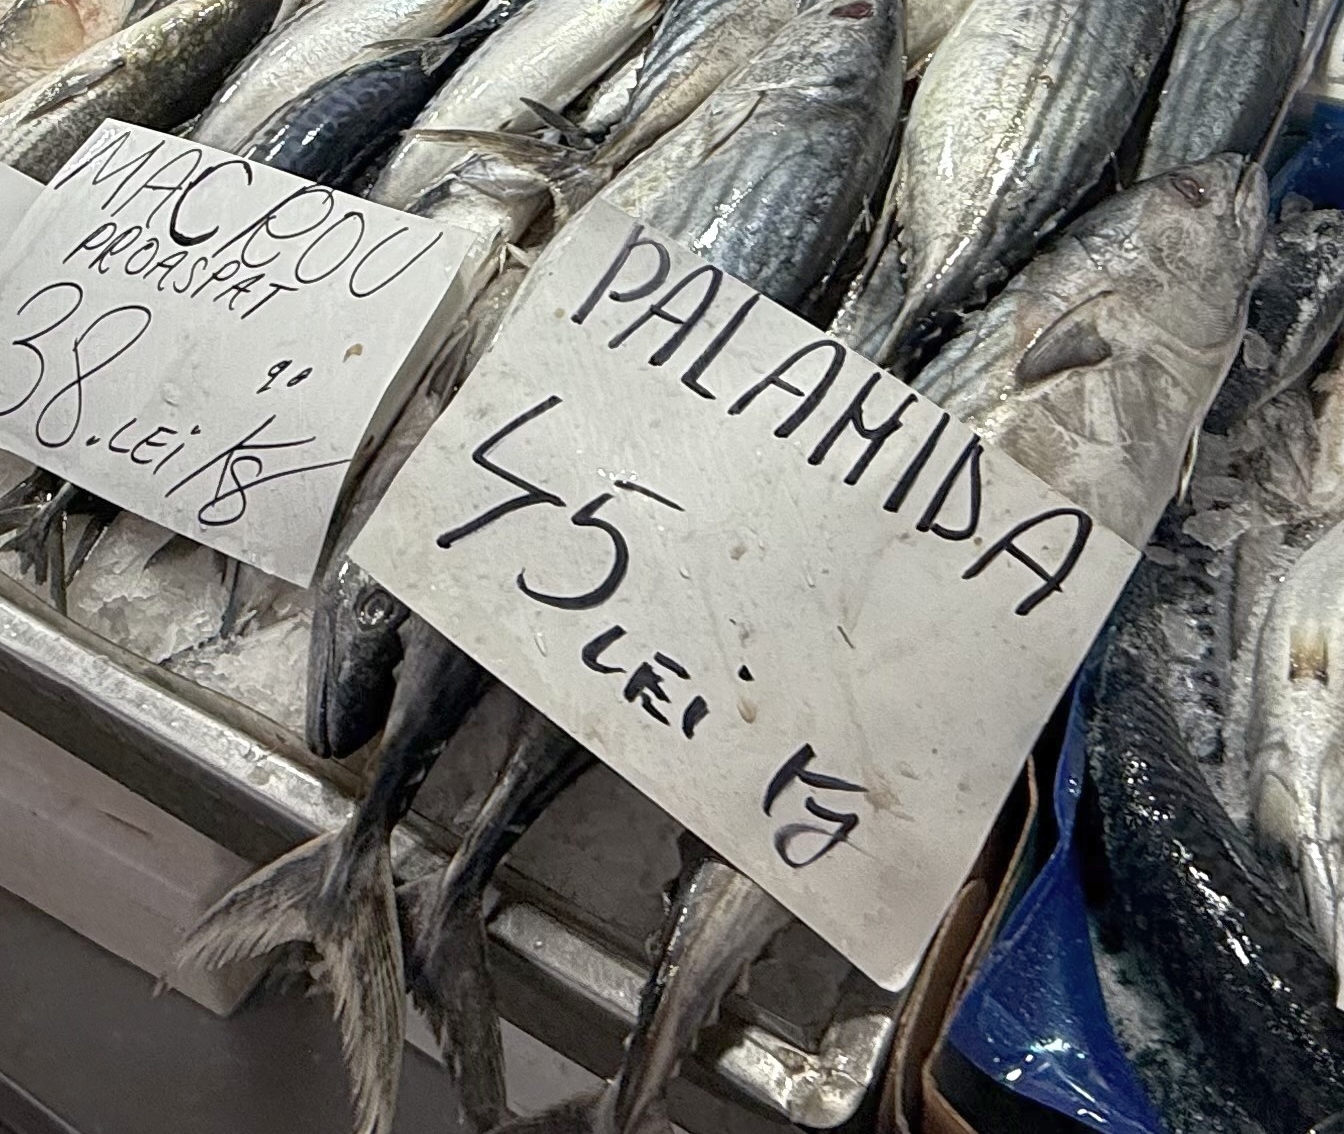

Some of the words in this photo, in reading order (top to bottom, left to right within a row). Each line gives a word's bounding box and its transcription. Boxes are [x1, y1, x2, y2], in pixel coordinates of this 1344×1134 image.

[54, 130, 444, 299] MACROU
[62, 220, 299, 320] PROASPAT
[436, 393, 685, 610] 45
[570, 223, 1094, 618] PALAMIDA
